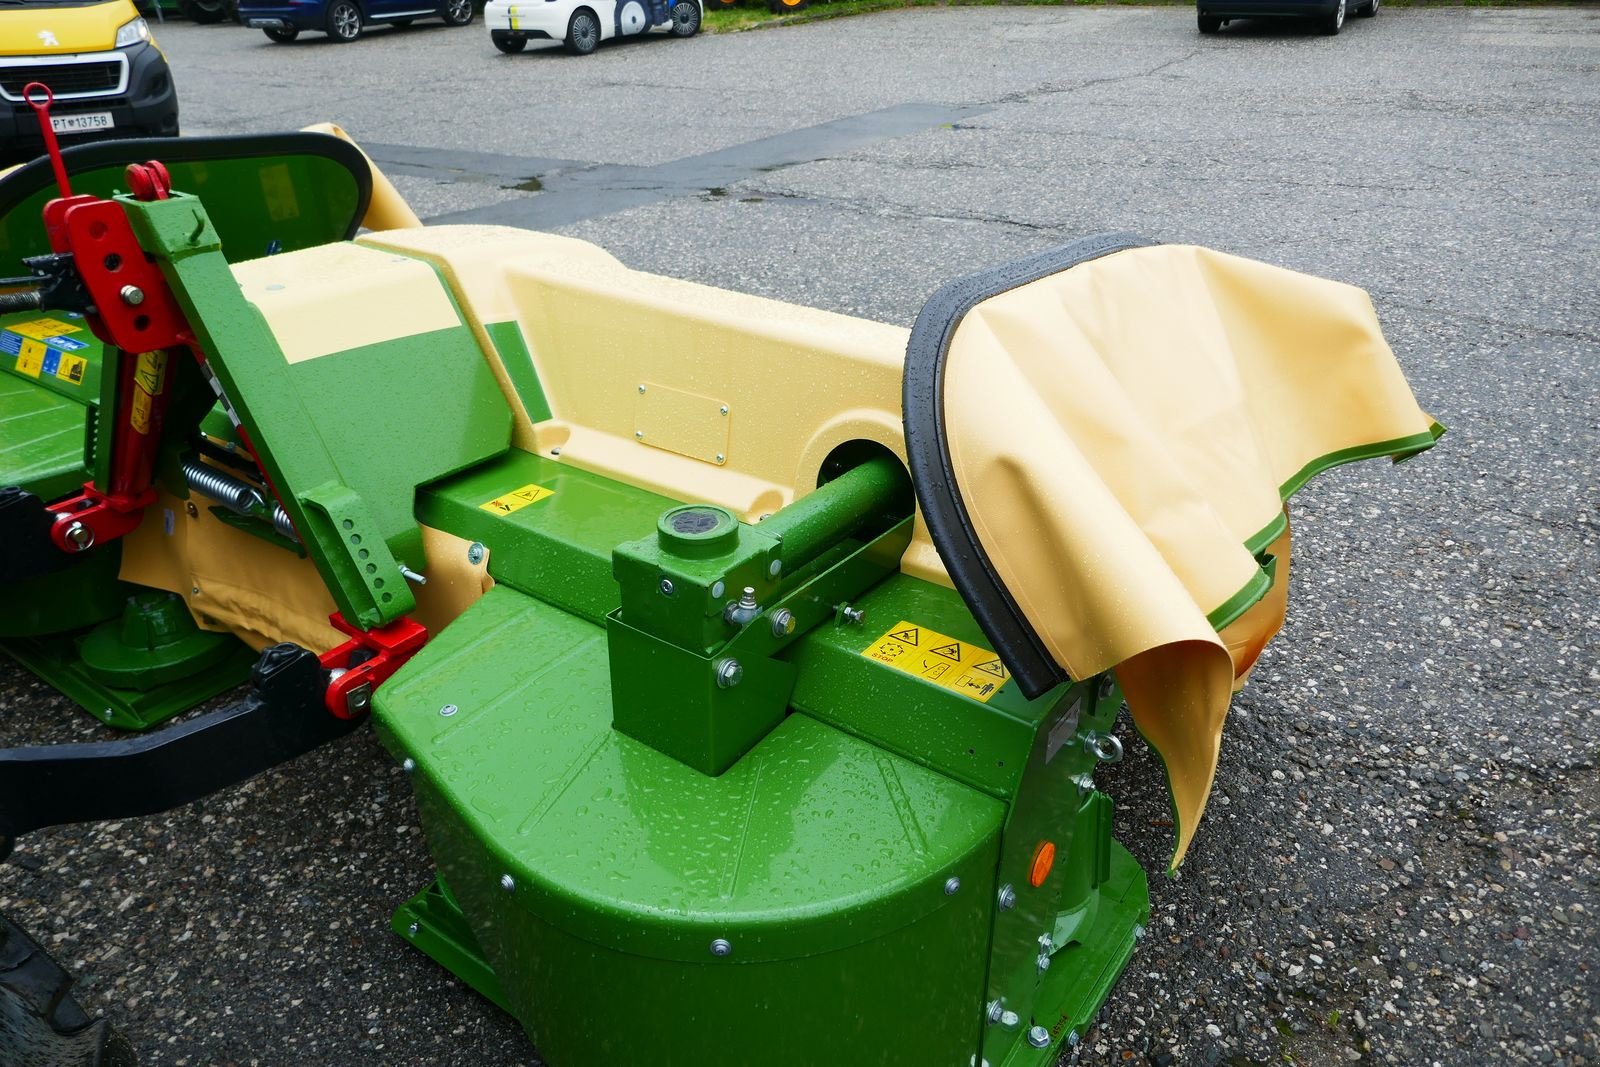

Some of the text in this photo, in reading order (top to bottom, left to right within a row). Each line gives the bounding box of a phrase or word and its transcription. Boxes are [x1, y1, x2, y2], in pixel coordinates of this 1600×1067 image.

[53, 116, 107, 129] PT 13758
[871, 653, 894, 662] STOP
